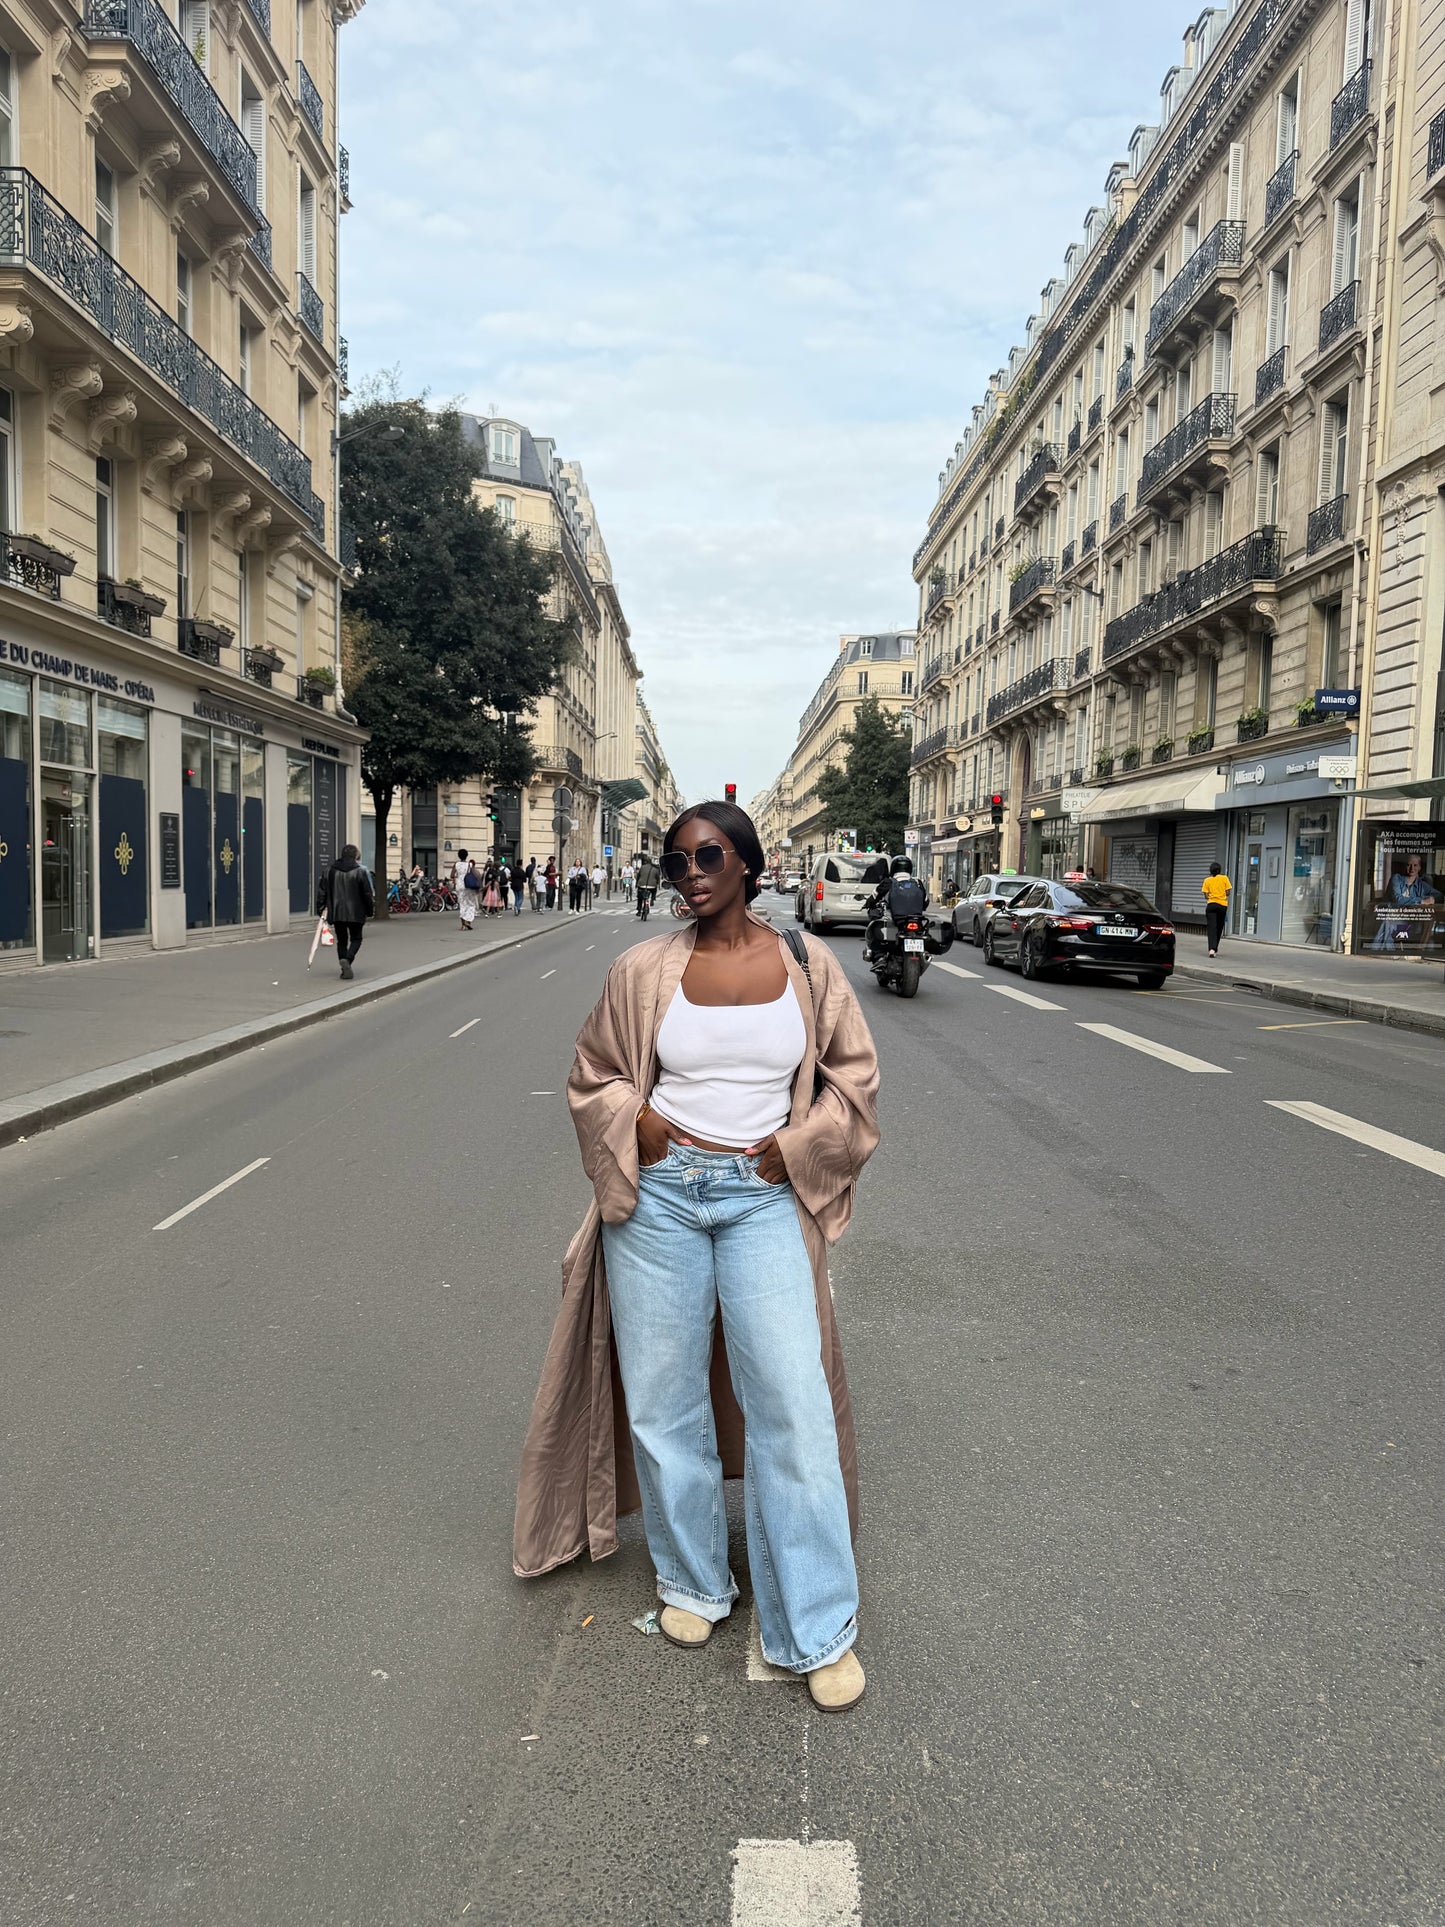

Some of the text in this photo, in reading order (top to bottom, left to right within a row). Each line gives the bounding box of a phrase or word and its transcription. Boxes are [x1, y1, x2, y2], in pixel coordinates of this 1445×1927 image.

[10, 643, 28, 664] DU
[31, 650, 73, 677] CHAMP
[74, 663, 90, 683] DE
[91, 668, 119, 692] MARS
[125, 680, 155, 702] OPÉRA
[1320, 695, 1346, 704] Allianz
[1234, 770, 1256, 784] Allianz
[1396, 831, 1437, 839] accompagne
[1396, 931, 1409, 939] AXA
